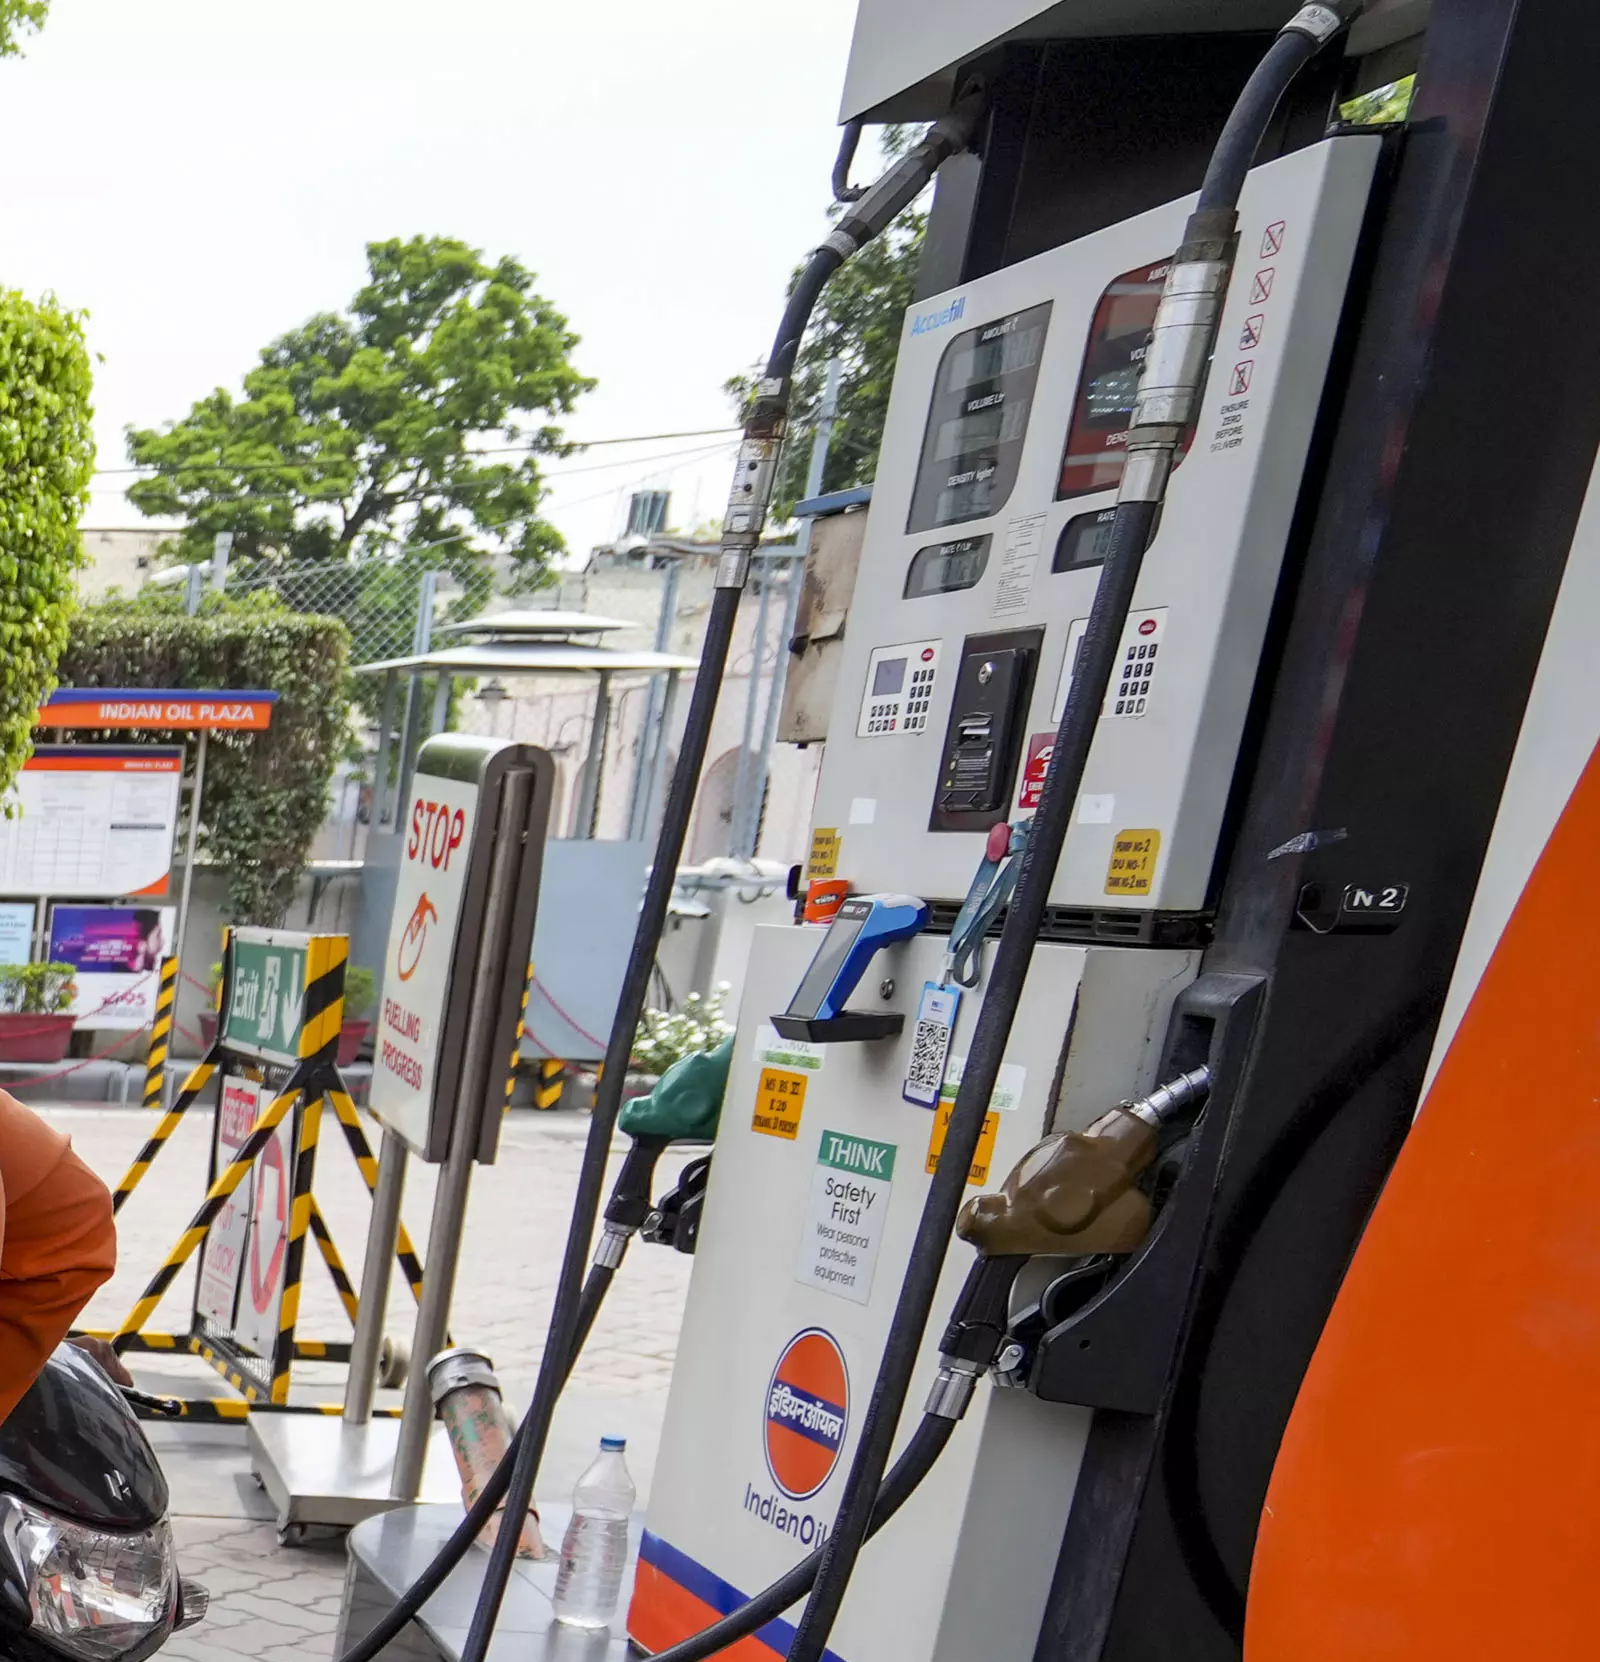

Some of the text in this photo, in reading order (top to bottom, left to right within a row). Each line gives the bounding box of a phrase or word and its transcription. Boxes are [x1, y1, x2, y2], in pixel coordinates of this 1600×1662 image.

[1220, 400, 1249, 415] ENSURE
[1221, 414, 1242, 427] ZERO
[1215, 425, 1243, 440] BEFORE
[99, 703, 254, 721] INDIAN OIL PLAZA
[408, 798, 465, 873] STOP
[232, 964, 260, 1021] Exit
[384, 997, 421, 1043] FUELLING
[380, 1039, 423, 1092] PROGRESS
[828, 1137, 887, 1174] THINK
[825, 1177, 876, 1210] Safety
[831, 1201, 861, 1226] First
[816, 1221, 871, 1250] Wear personal
[819, 1246, 857, 1268] protective
[814, 1264, 856, 1287] equipment
[768, 1383, 845, 1442] इंडियनऑयल
[744, 1482, 829, 1550] IndianOil
